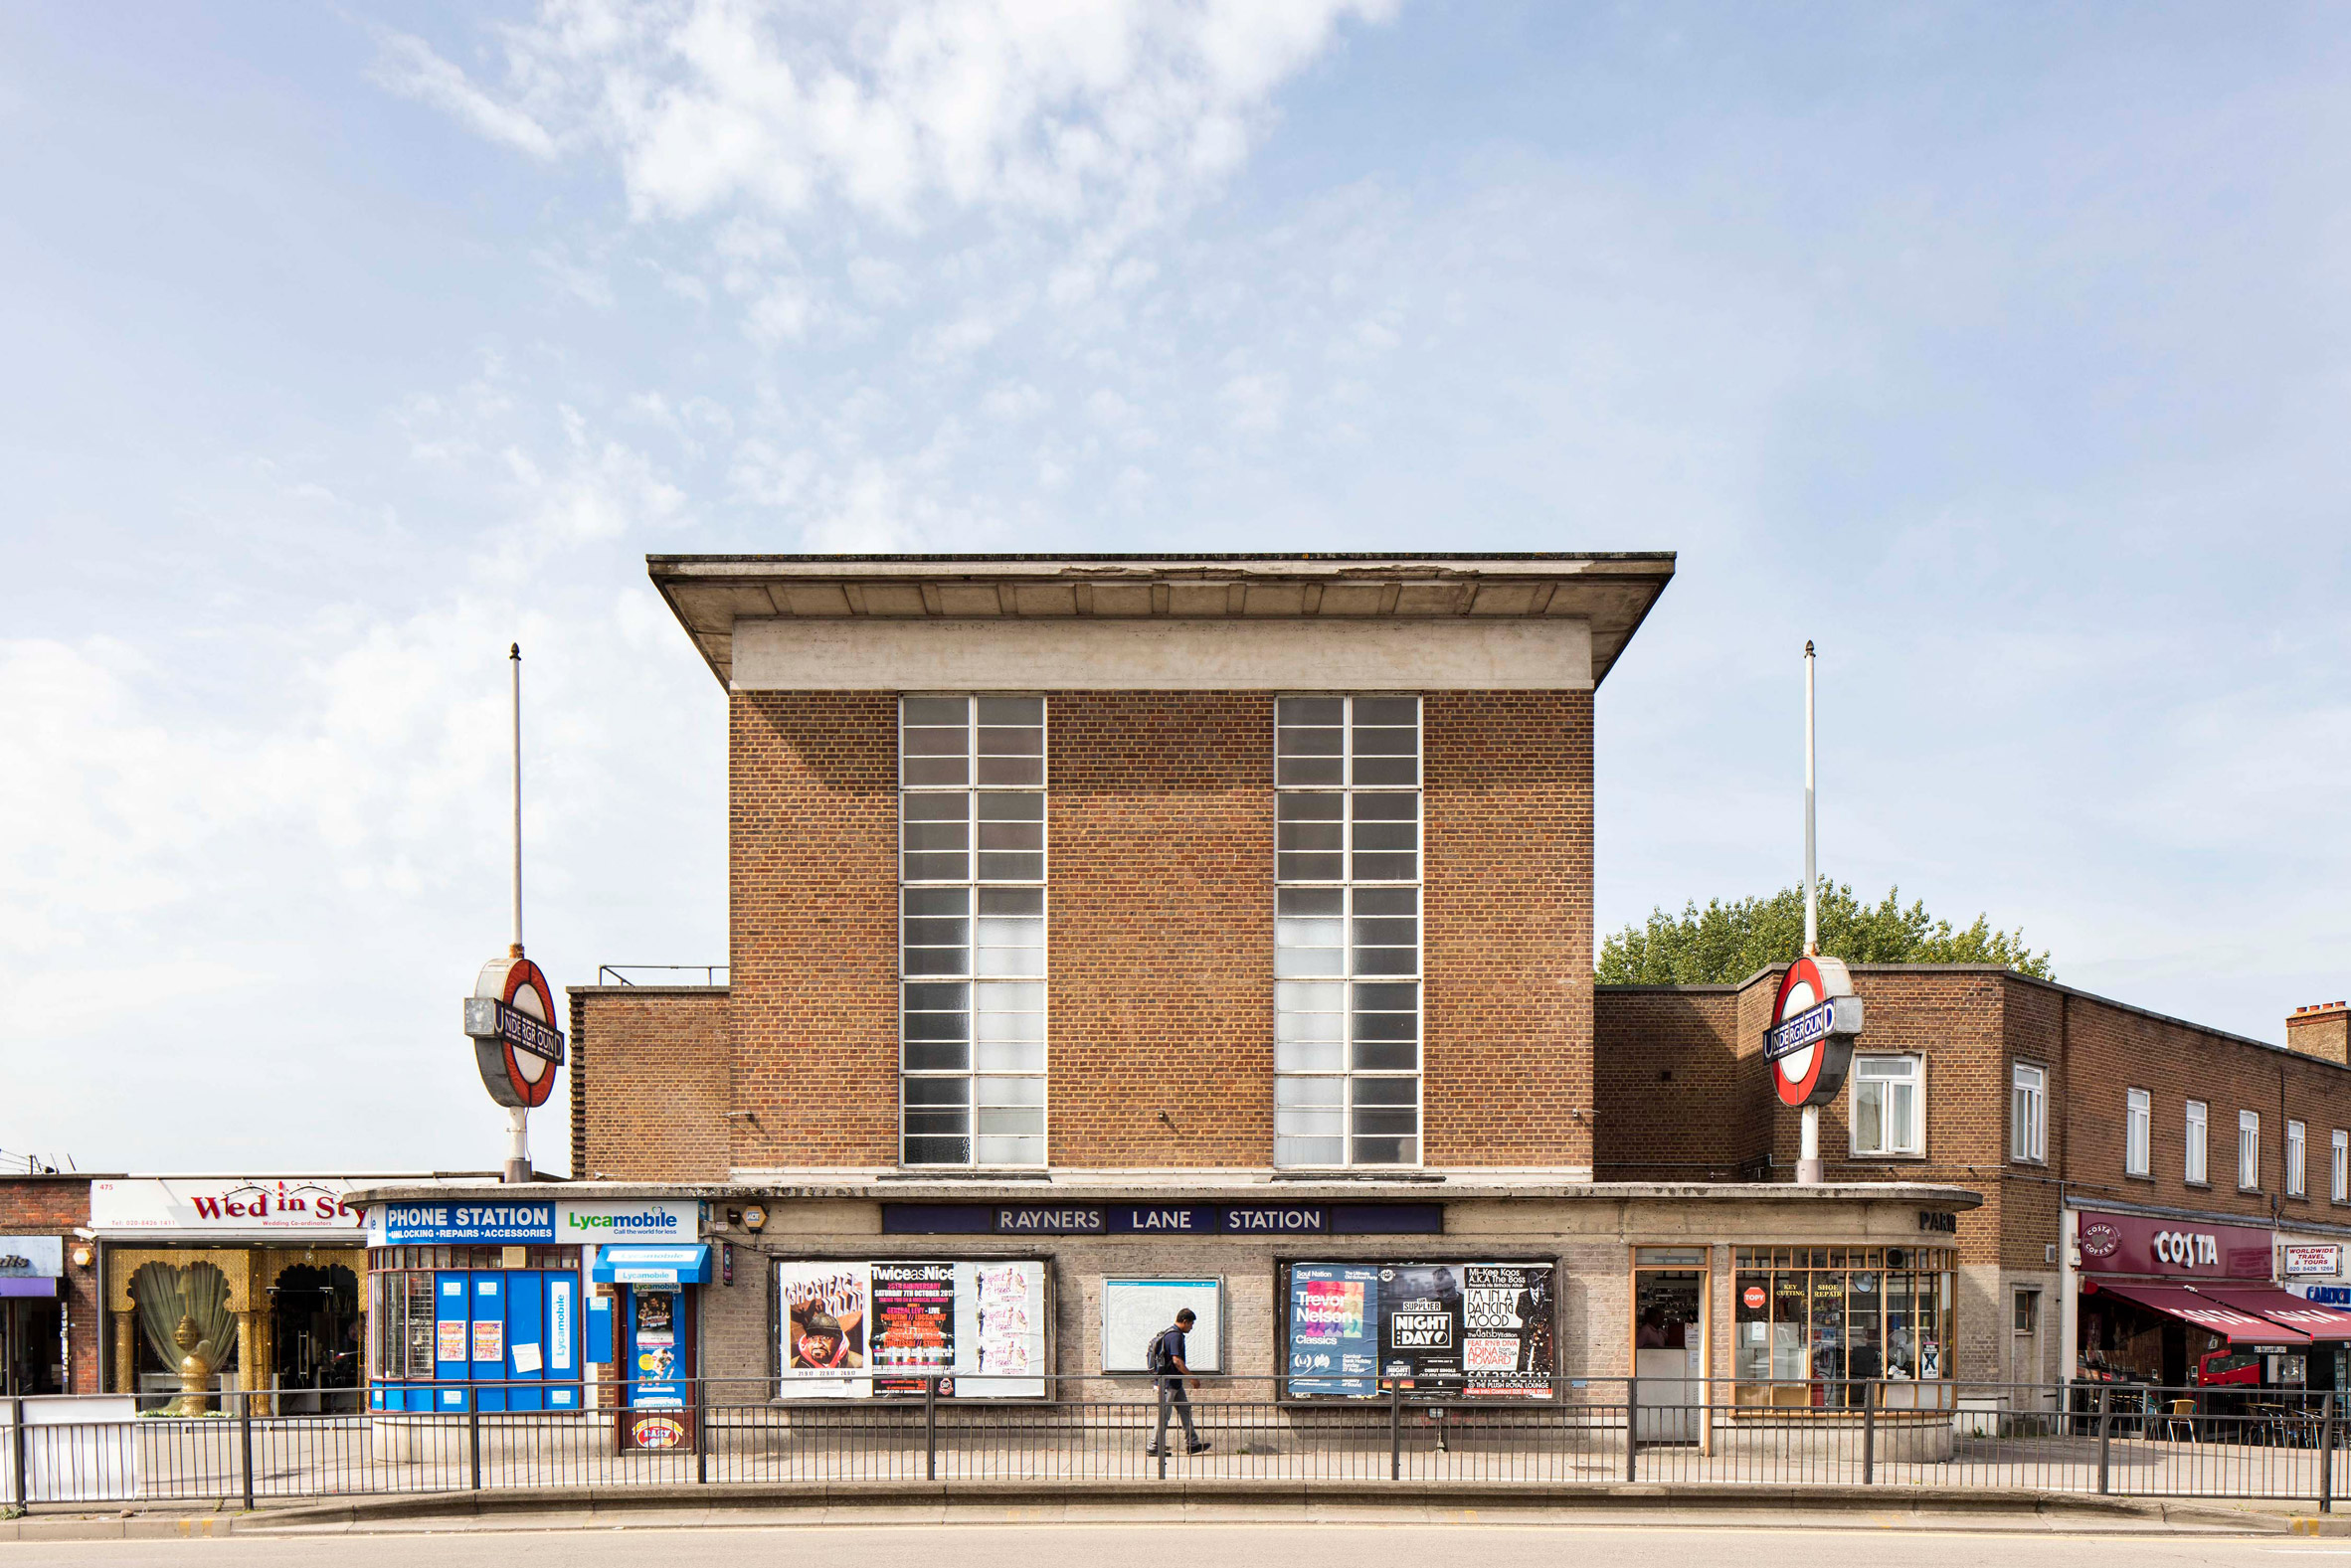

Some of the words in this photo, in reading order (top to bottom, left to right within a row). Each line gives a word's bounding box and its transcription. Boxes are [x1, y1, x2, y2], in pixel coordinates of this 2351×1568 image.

[494, 1004, 563, 1060] UNDERGROUND
[1764, 1002, 1835, 1059] UNDERGROUND
[191, 1194, 268, 1220] Wed
[277, 1191, 306, 1212] in
[388, 1208, 449, 1226] PHONE
[455, 1207, 549, 1226] STATION
[569, 1210, 677, 1231] Lycamobile
[1000, 1211, 1101, 1229] RAYNERS
[1133, 1211, 1191, 1228] LANE
[1229, 1210, 1321, 1229] STATION
[2086, 1225, 2110, 1236] COSTA
[2085, 1243, 2113, 1255] COFFEE
[2156, 1231, 2219, 1269] COSTA
[821, 1290, 865, 1317] KILLAH
[1296, 1291, 1348, 1307] Trevor
[1468, 1290, 1483, 1302] I'M
[1489, 1290, 1500, 1302] IN
[1505, 1290, 1513, 1302] A
[1296, 1307, 1354, 1323] Nelson
[1468, 1302, 1513, 1314] DANCING
[2264, 1308, 2348, 1323] COSTA
[1395, 1315, 1448, 1330] NIGHT
[1467, 1314, 1510, 1327] MOOD
[2169, 1308, 2261, 1325] COSTA
[557, 1294, 567, 1356] Lycamobile
[1295, 1334, 1338, 1345] Classics
[1401, 1330, 1435, 1345] DAY
[1476, 1327, 1501, 1339] Gatsby
[1467, 1347, 1498, 1356] ADINA
[1467, 1355, 1512, 1365] HOWARD
[1468, 1371, 1490, 1383] SAT
[1536, 1371, 1550, 1383] 17
